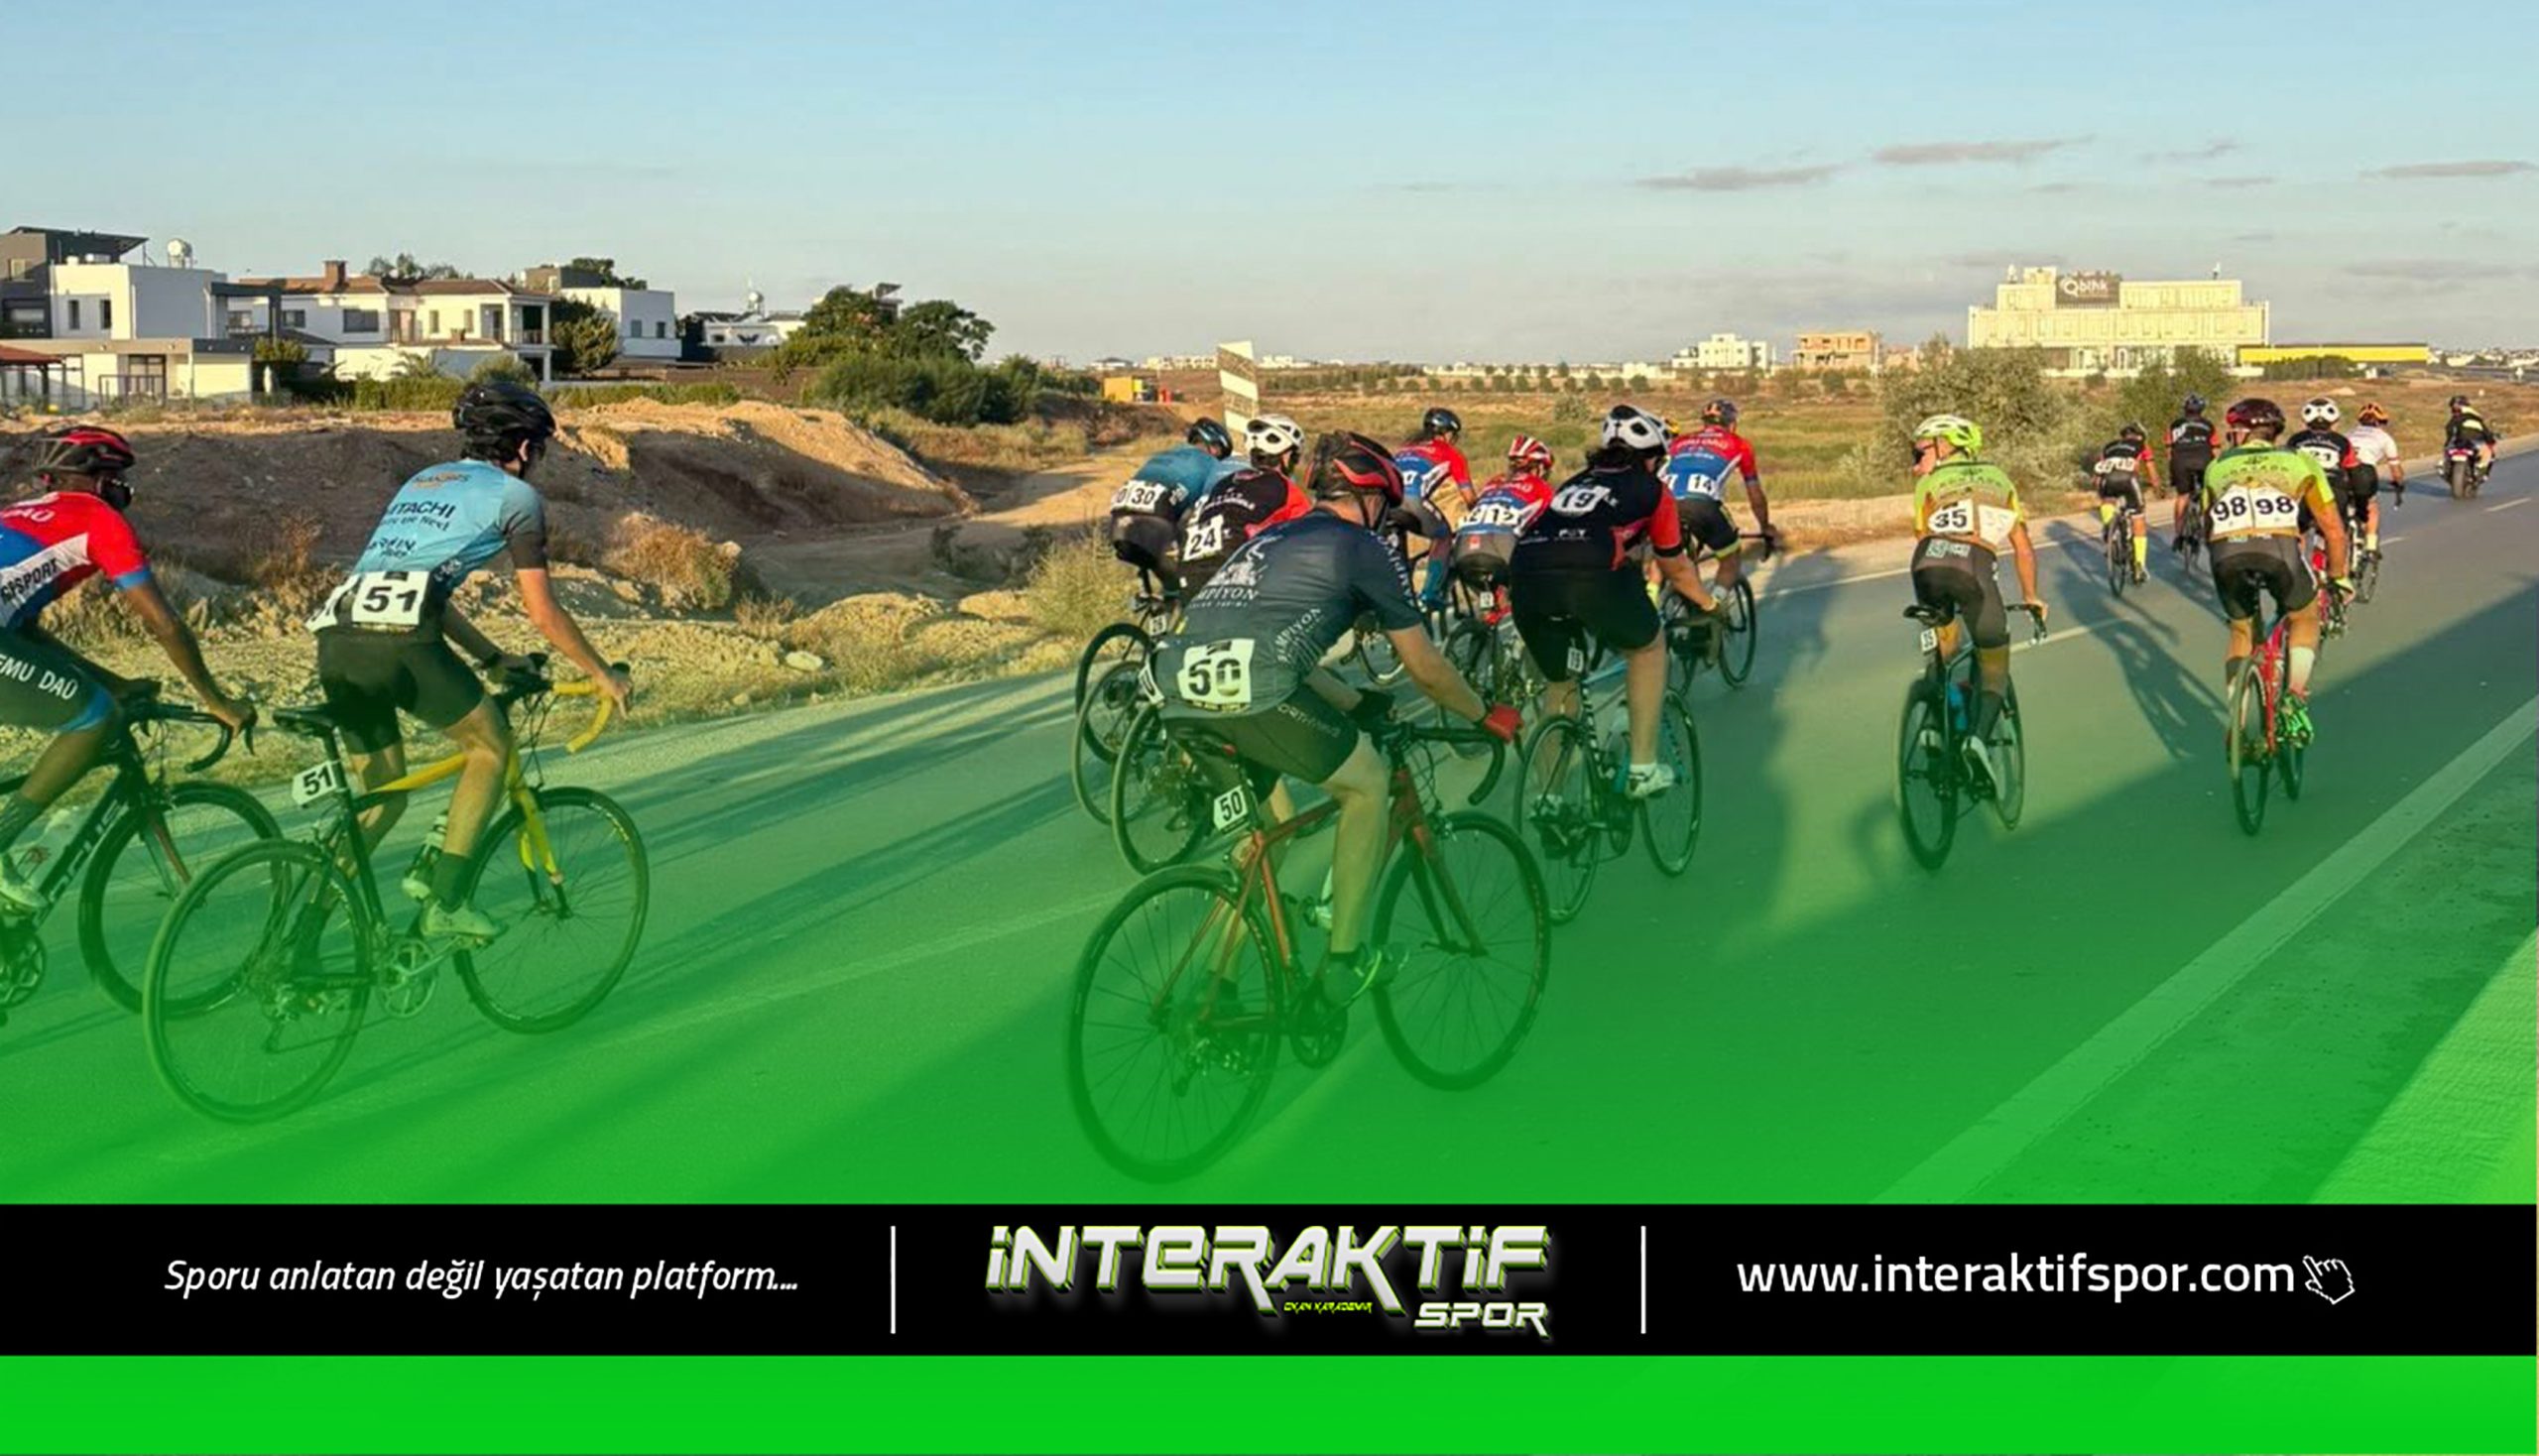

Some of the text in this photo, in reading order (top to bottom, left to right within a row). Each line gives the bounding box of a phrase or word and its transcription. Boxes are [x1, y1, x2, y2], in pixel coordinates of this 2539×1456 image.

[1131, 487, 1153, 505] 30
[1561, 491, 1595, 509] 19
[2213, 496, 2247, 522] 98
[2255, 496, 2294, 515] 98
[1934, 508, 1968, 529] 35
[1190, 527, 1216, 553] 24
[362, 586, 419, 613] 51
[1188, 658, 1241, 696] 50
[302, 764, 333, 796] 51
[1220, 789, 1242, 821] 50
